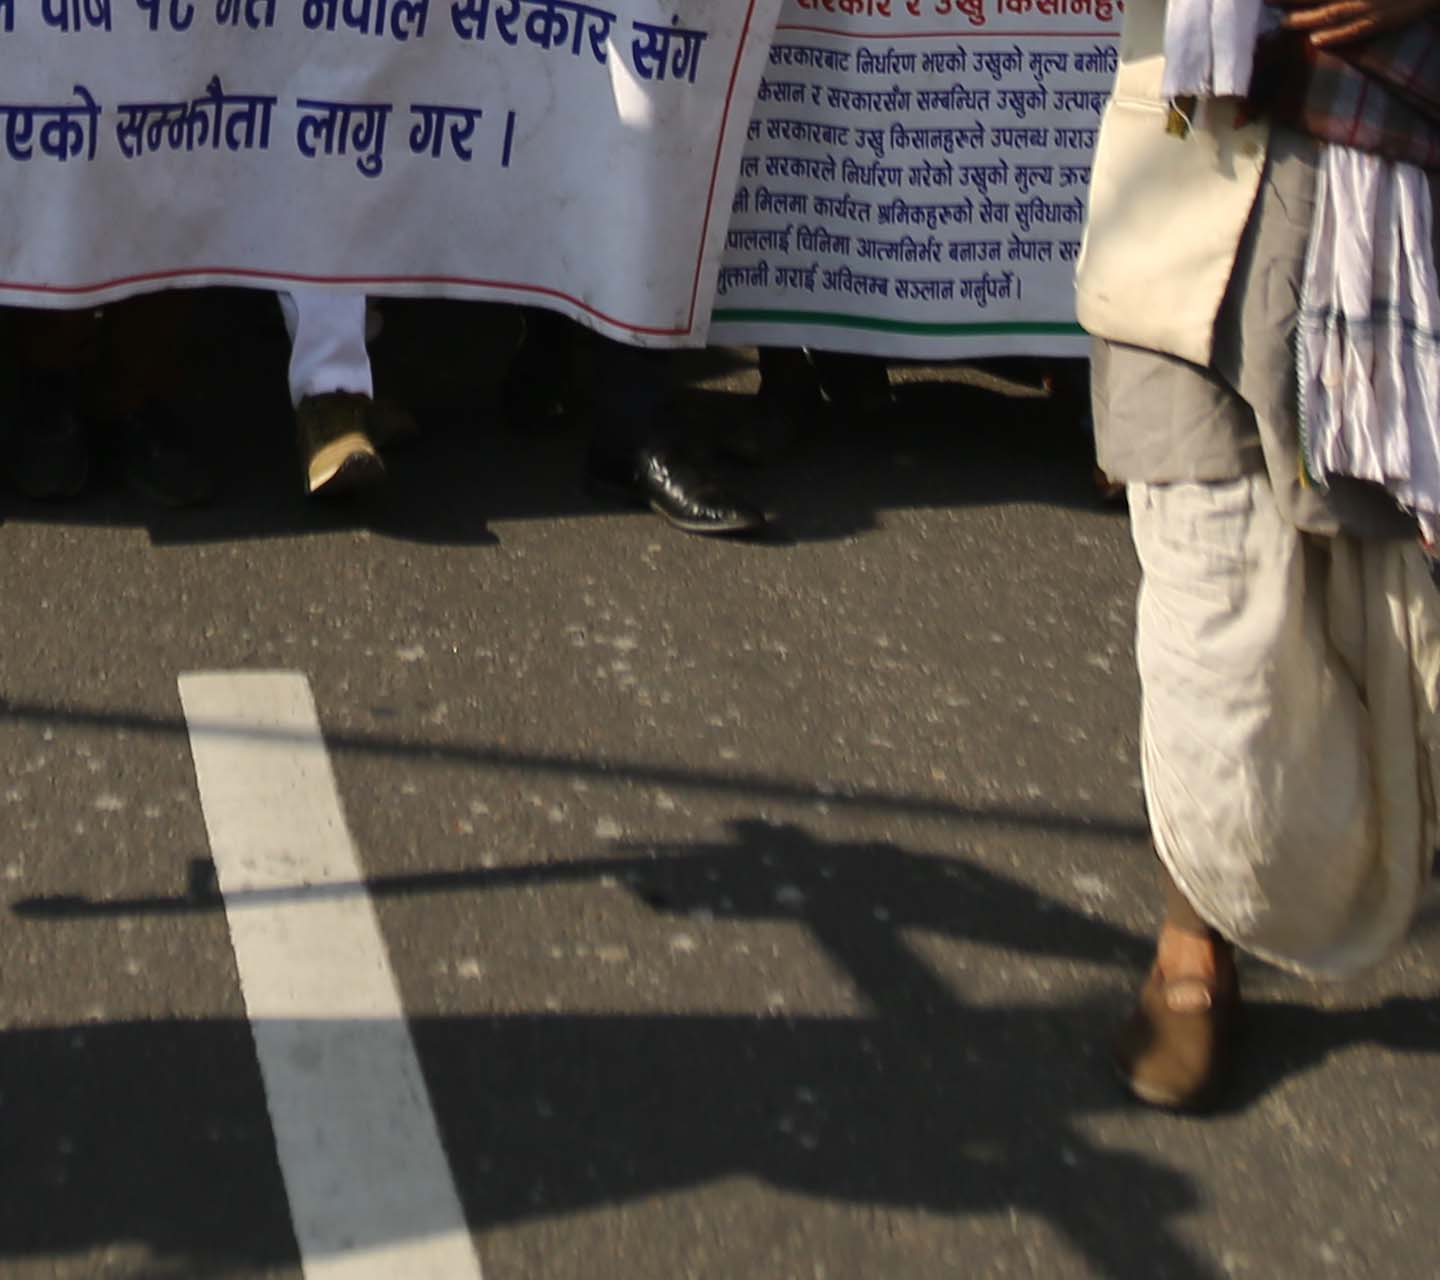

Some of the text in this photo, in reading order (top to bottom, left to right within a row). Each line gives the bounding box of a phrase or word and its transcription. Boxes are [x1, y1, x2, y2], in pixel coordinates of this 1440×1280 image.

[631, 14, 708, 83] संग
[769, 44, 851, 71] सरकारबाट
[856, 46, 916, 75] निर्धारण
[922, 45, 967, 74] भएको
[973, 44, 1021, 81] उखुको
[1029, 51, 1067, 81] मुल्य
[812, 86, 822, 106] र
[917, 85, 989, 113] सम्बन्धित
[996, 83, 1047, 118] उखुको
[116, 74, 277, 159] सम्झौता
[297, 97, 392, 178] लागु
[410, 104, 482, 161] गर
[767, 119, 851, 147] सरकारबाट
[856, 129, 886, 157] उखु
[990, 127, 1047, 149] उपलब्ध
[765, 154, 836, 183] सरकारले
[842, 156, 902, 188] निर्धारण
[909, 159, 954, 187] गरेको
[958, 158, 1009, 194] उखुको
[1015, 165, 1053, 192] मुल्य
[755, 186, 807, 216] मिलमा
[814, 193, 871, 223] कार्यरत
[979, 195, 1009, 223] सेवा
[1015, 196, 1083, 232] सुविधाको
[856, 233, 942, 263] आत्मनिर्भर
[948, 241, 1001, 262] बनाउन
[1008, 232, 1053, 262] नेपाल
[775, 263, 820, 293] गराई
[823, 265, 888, 298] अविलम्ब
